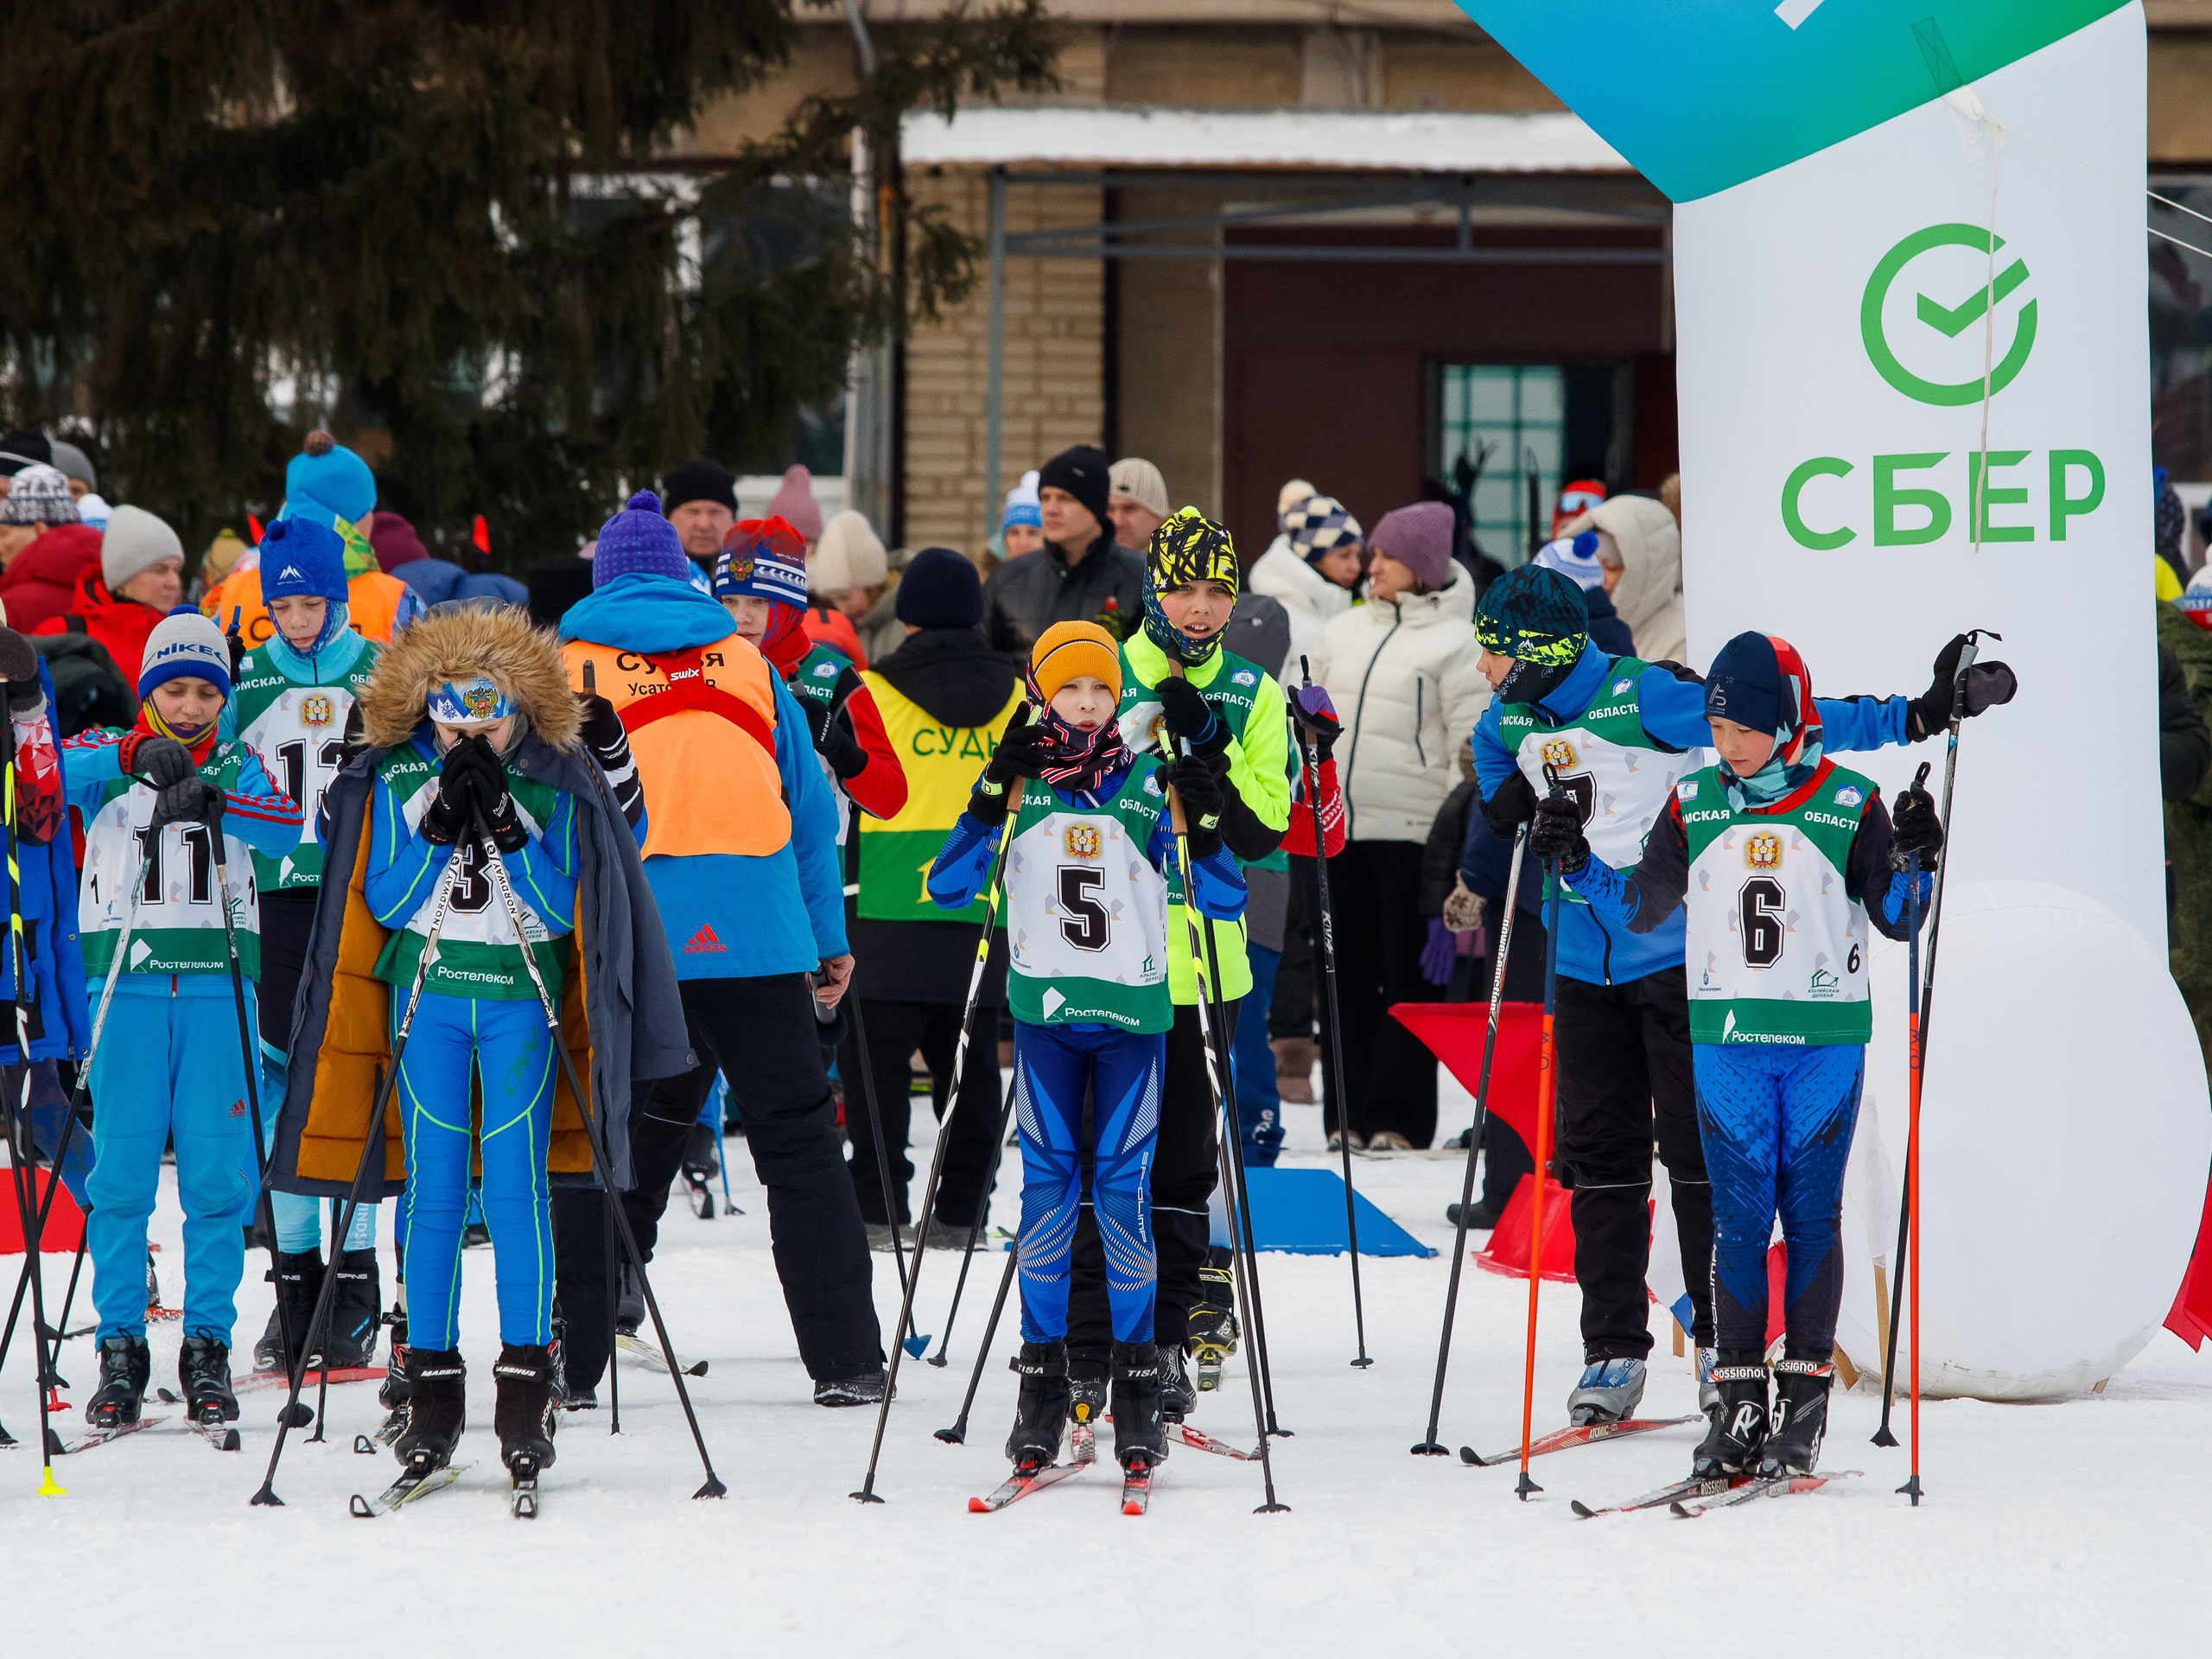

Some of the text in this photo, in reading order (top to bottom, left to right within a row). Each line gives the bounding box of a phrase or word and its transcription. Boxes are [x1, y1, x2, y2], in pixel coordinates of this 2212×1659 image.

[1781, 448, 2106, 550] СБЕР
[670, 667, 700, 681] swix
[1499, 702, 1639, 727] МСКАЯ ОБЛАСТЬ
[1682, 810, 1730, 824] МСКАЯ
[132, 823, 213, 905] 11
[448, 843, 493, 914] 3
[493, 863, 518, 914] NORDWAY
[433, 874, 453, 925] NORDWAY
[1057, 865, 1111, 952] 5
[1738, 876, 1786, 969] 6
[683, 942, 728, 954] adidas
[149, 959, 224, 969] Ростелеком
[1847, 943, 1860, 974] 6
[437, 965, 514, 985] Ростелеком
[1732, 1030, 1806, 1045] Ростелеком
[1017, 1363, 1044, 1375] TISA
[1128, 1367, 1158, 1377] TISA
[1713, 1368, 1766, 1379] ROSSIGNOL
[1588, 1425, 1609, 1440] ATOMIC
[1700, 1478, 1729, 1496] ROSSIGNOL
